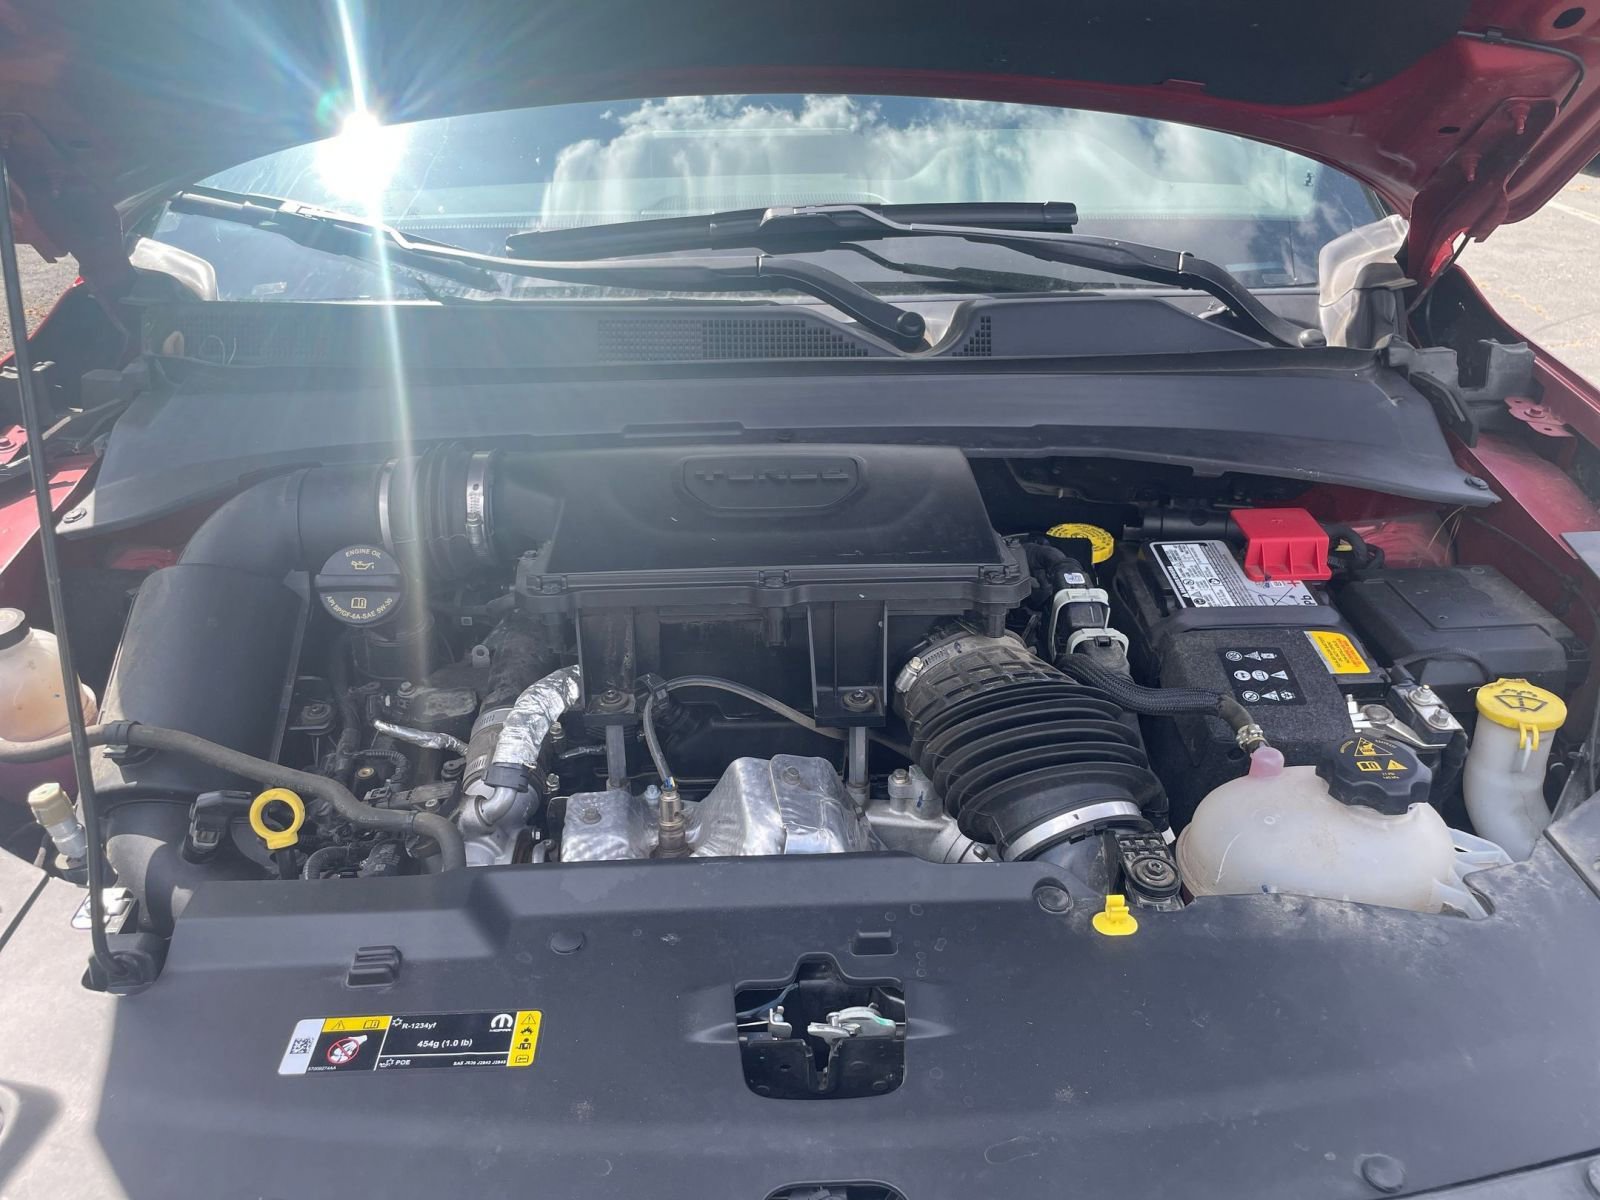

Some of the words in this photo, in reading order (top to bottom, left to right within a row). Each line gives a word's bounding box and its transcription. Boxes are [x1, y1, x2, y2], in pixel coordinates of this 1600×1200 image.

[345, 548, 370, 557] ENGINE
[371, 550, 381, 559] OIL
[326, 596, 336, 607] API
[376, 598, 393, 614] 5W-30
[402, 1022, 437, 1030] R-1234yf
[417, 1040, 440, 1049] 454g
[441, 1040, 459, 1048] (1.0
[460, 1039, 473, 1048] lb)
